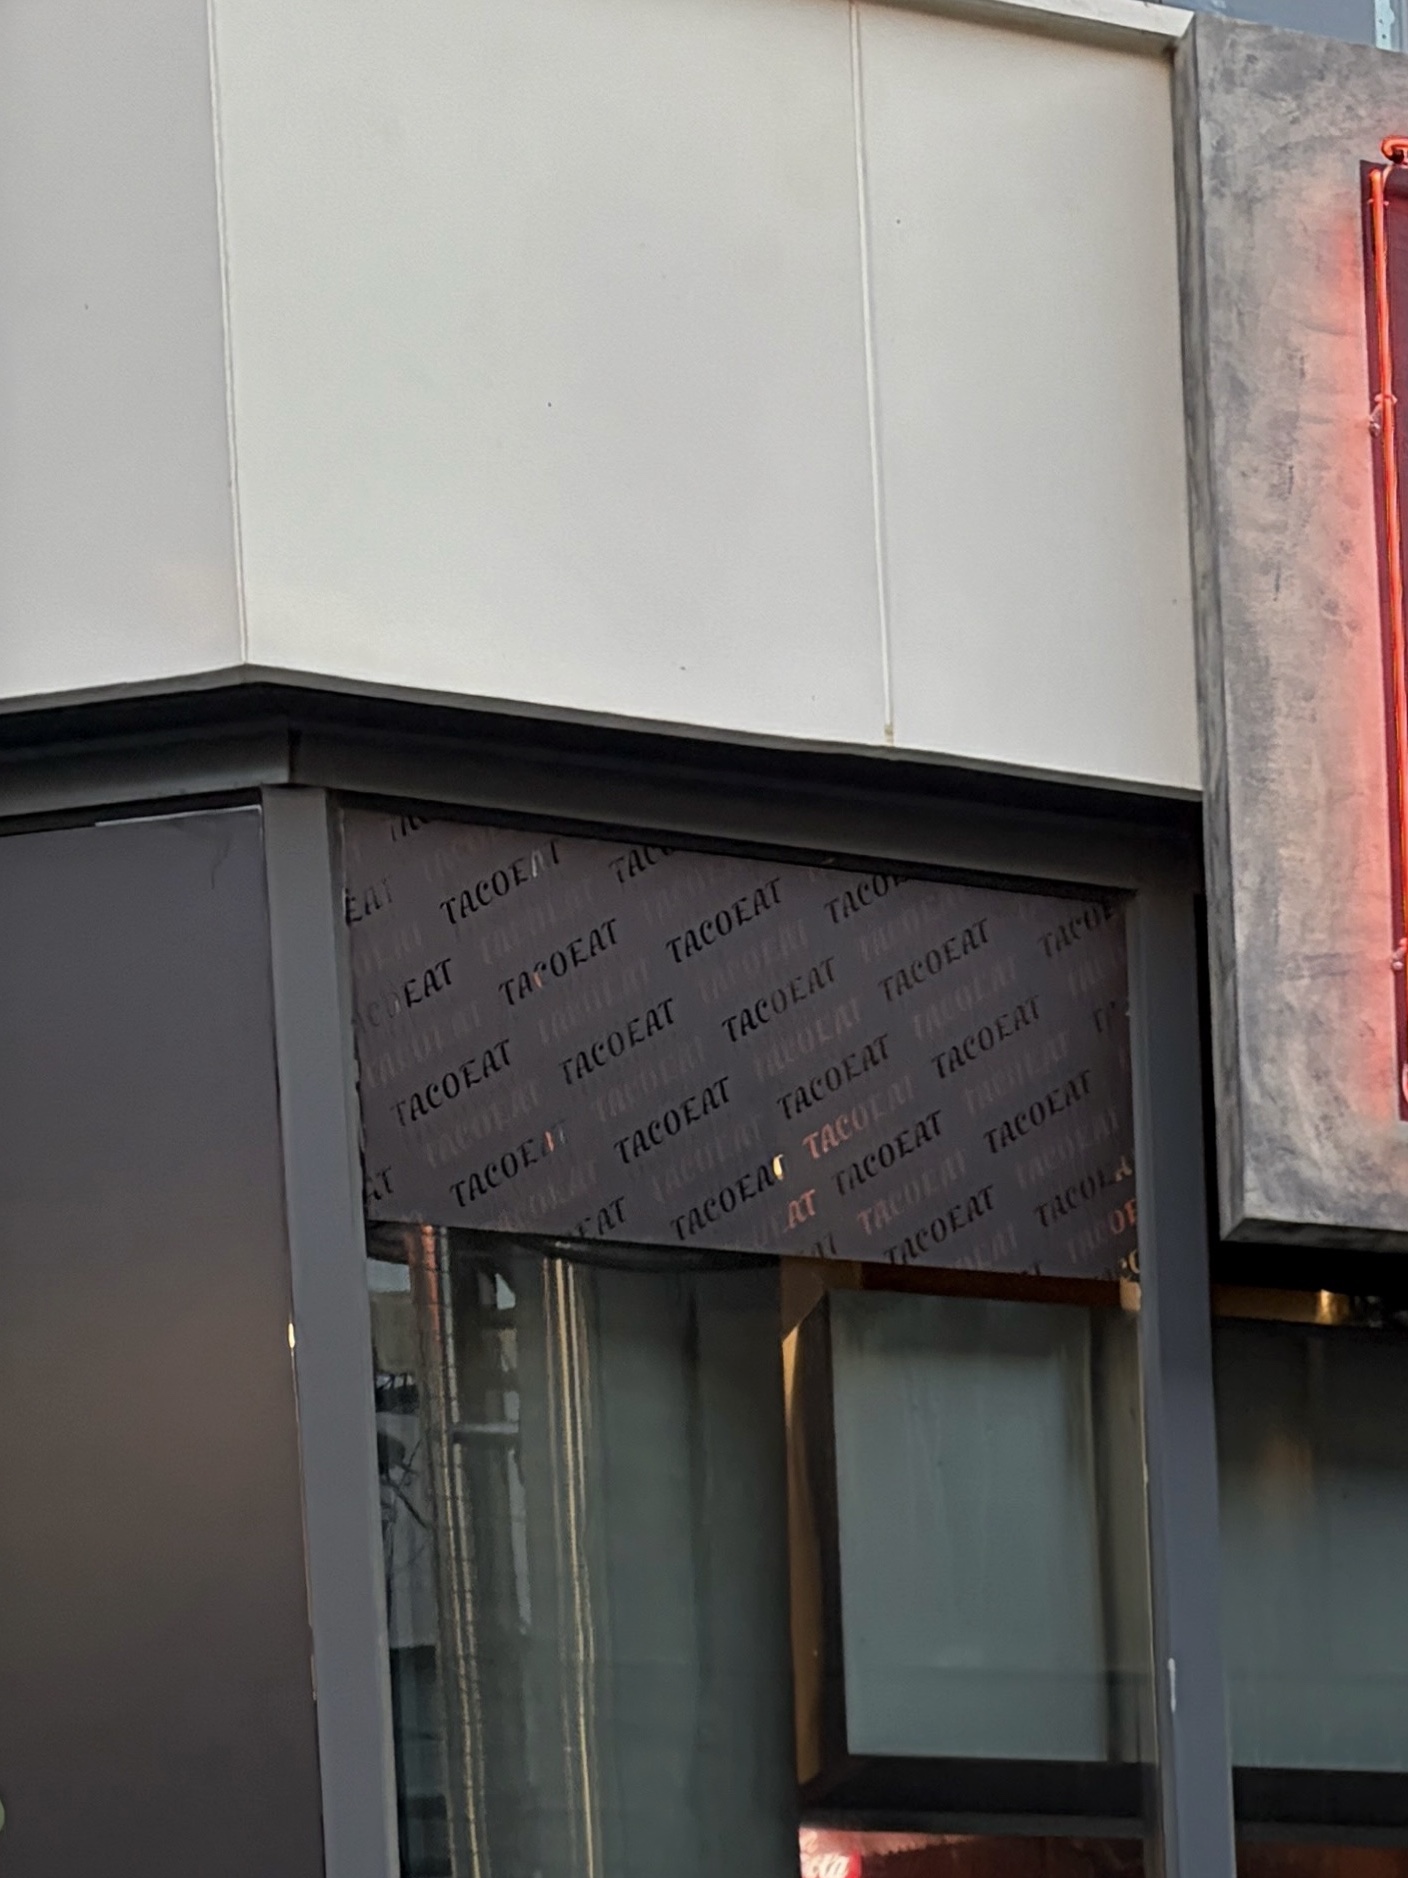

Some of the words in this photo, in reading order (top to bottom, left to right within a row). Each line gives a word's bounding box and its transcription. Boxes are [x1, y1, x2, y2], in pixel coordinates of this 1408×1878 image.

[497, 918, 619, 1006] TACOEAT
[665, 877, 782, 964] TACOEAT
[877, 917, 990, 1003] TACOEAT
[559, 997, 676, 1086] TACOEAT
[721, 956, 837, 1043] TACOEAT
[931, 994, 1042, 1080] TACOEAT
[390, 1038, 513, 1128] TACOEAT
[612, 1076, 731, 1164] TACOEAT
[776, 1033, 891, 1121] TACOEAT
[983, 1069, 1093, 1155] TACOEAT
[832, 1109, 944, 1197] TACOEAT
